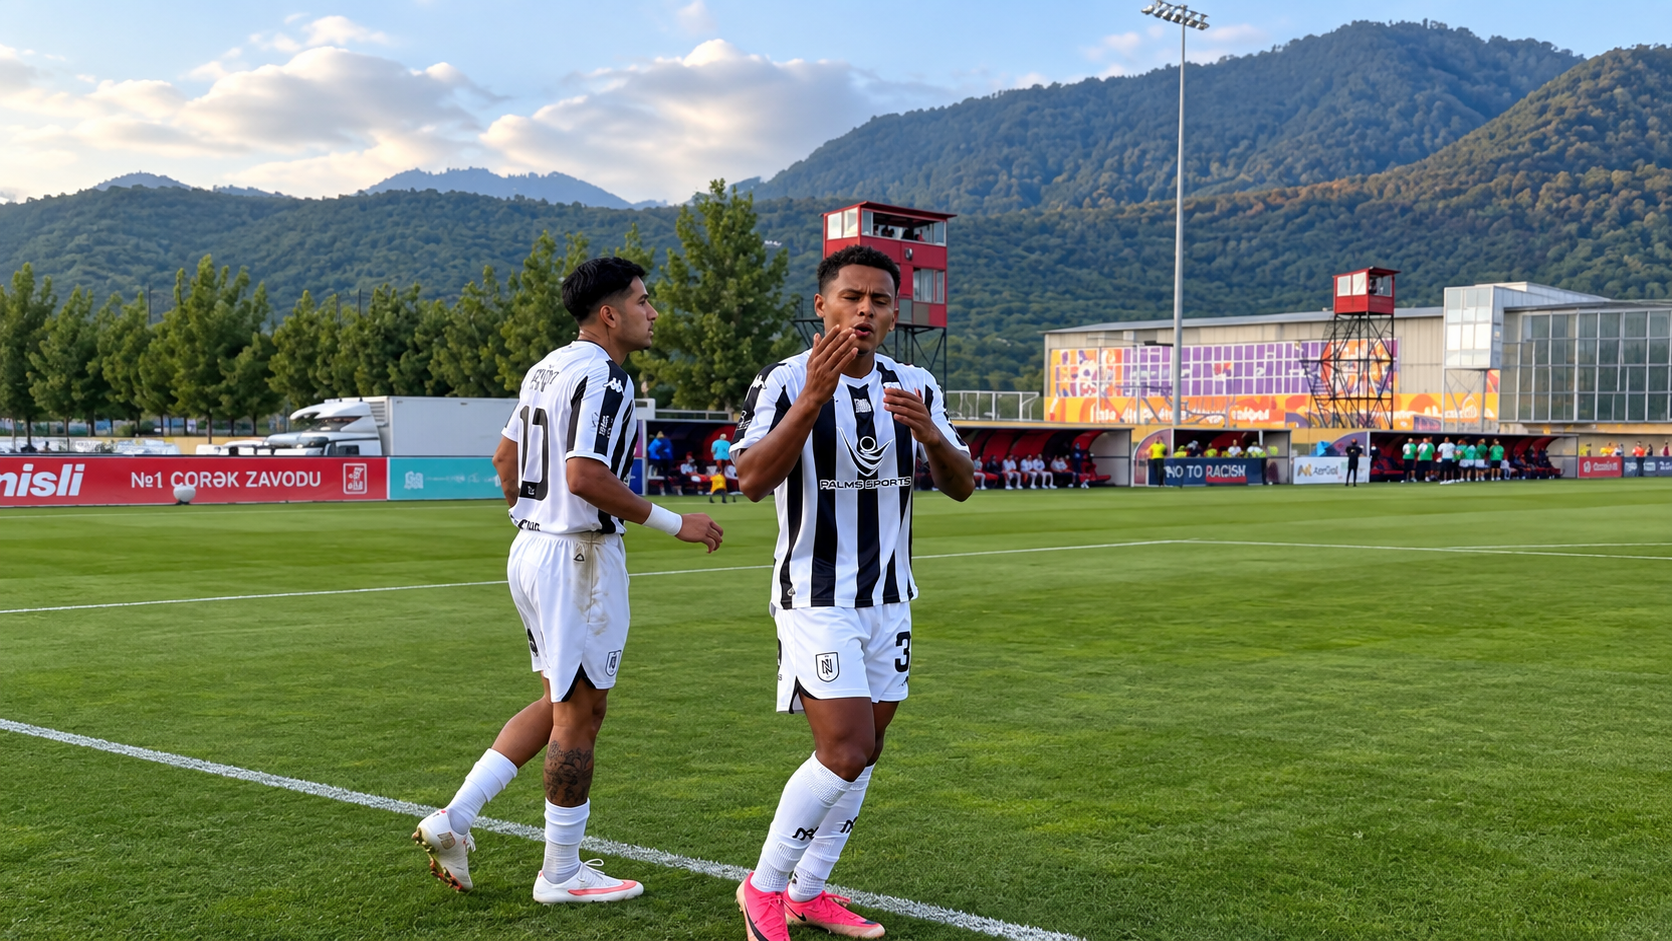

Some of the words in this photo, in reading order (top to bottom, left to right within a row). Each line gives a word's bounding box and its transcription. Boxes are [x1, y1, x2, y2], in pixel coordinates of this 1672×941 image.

[1186, 465, 1203, 478] TO
[245, 471, 321, 488] ZAVODU
[820, 480, 864, 490] PALMS
[864, 476, 912, 490] SPORTS
